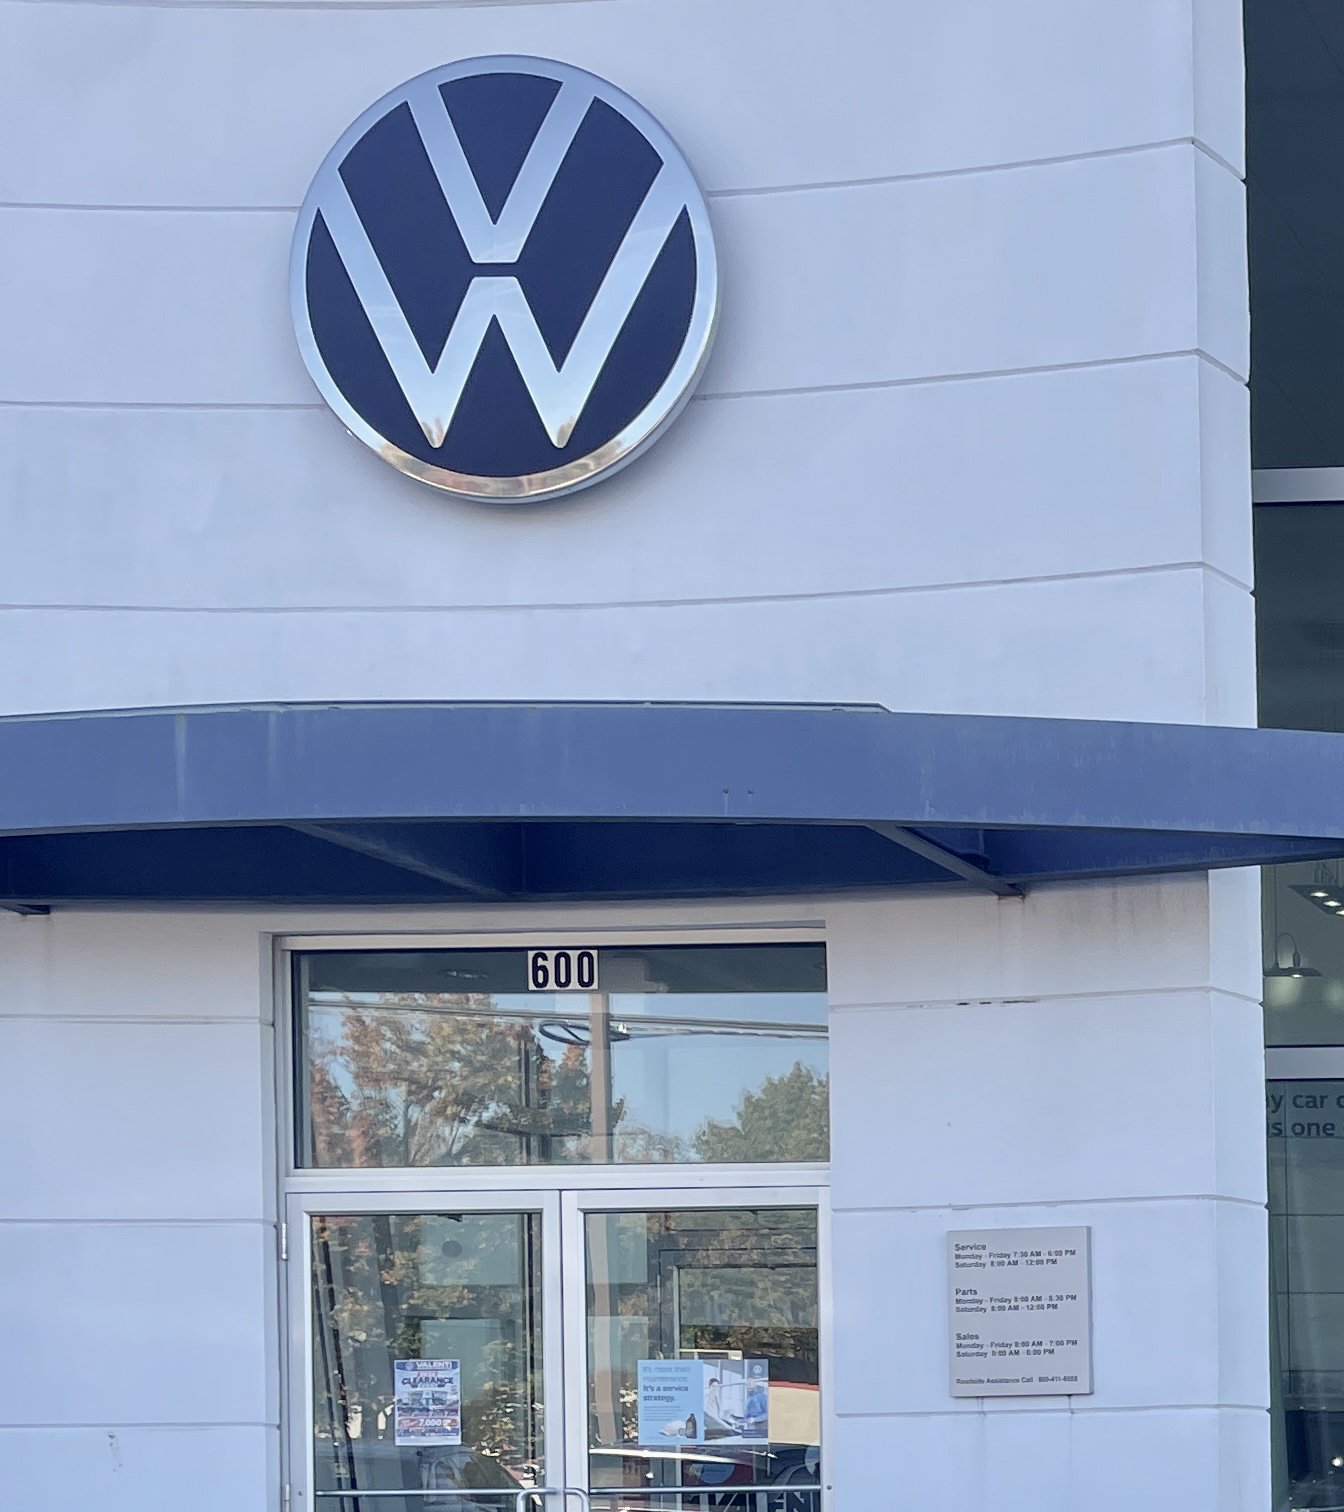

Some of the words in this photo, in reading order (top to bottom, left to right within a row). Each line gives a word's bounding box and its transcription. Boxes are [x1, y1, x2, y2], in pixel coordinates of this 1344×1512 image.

[293, 56, 716, 500] VW
[532, 951, 594, 988] 600
[1292, 1094, 1328, 1110] car
[1292, 1121, 1335, 1137] one
[956, 1333, 980, 1341] Sales
[990, 1341, 1012, 1349] Friday
[402, 1377, 454, 1385] CLEARANCE
